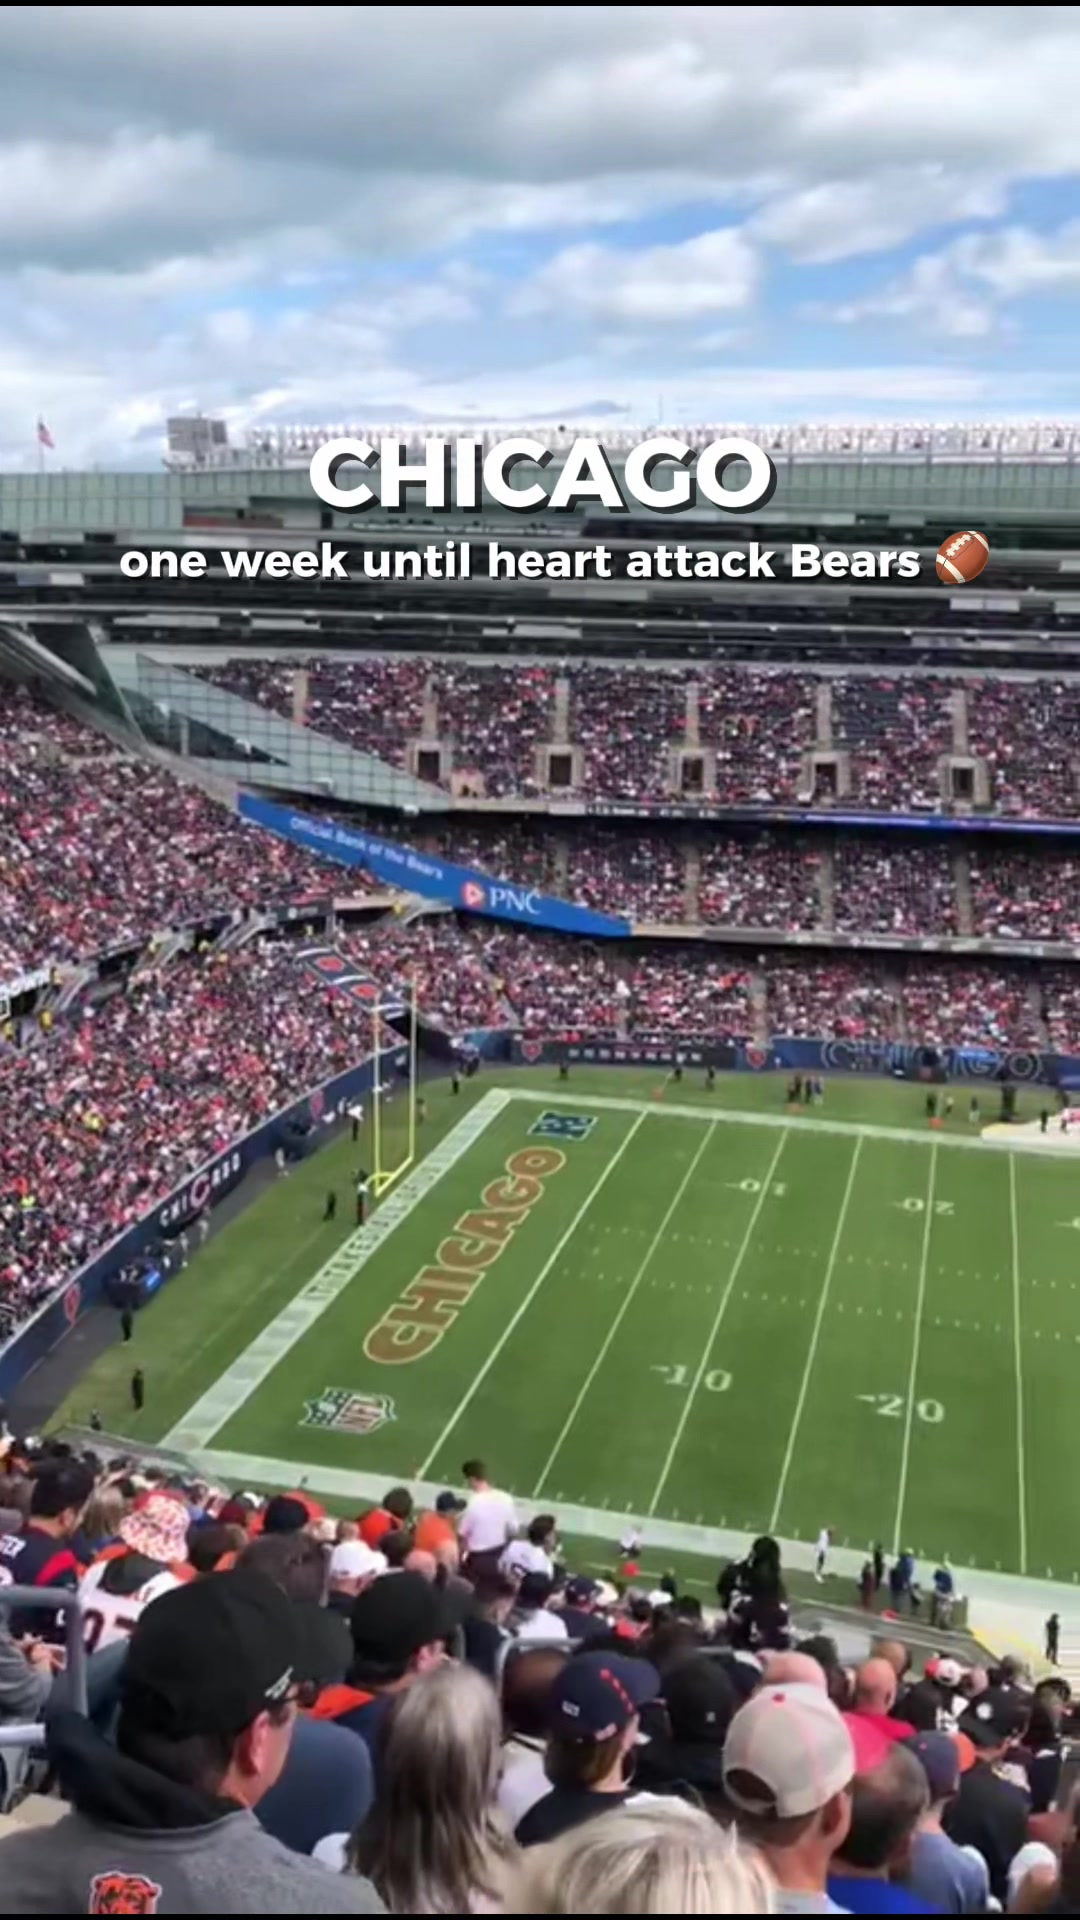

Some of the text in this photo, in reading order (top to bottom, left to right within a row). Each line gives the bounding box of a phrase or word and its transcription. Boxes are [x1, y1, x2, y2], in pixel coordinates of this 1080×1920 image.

[289, 816, 333, 839] Official
[335, 827, 366, 850] Bank
[489, 886, 541, 916] PNC
[363, 1146, 567, 1365] CHICAGO
[666, 1364, 733, 1393] 10
[876, 1393, 946, 1423] 20
